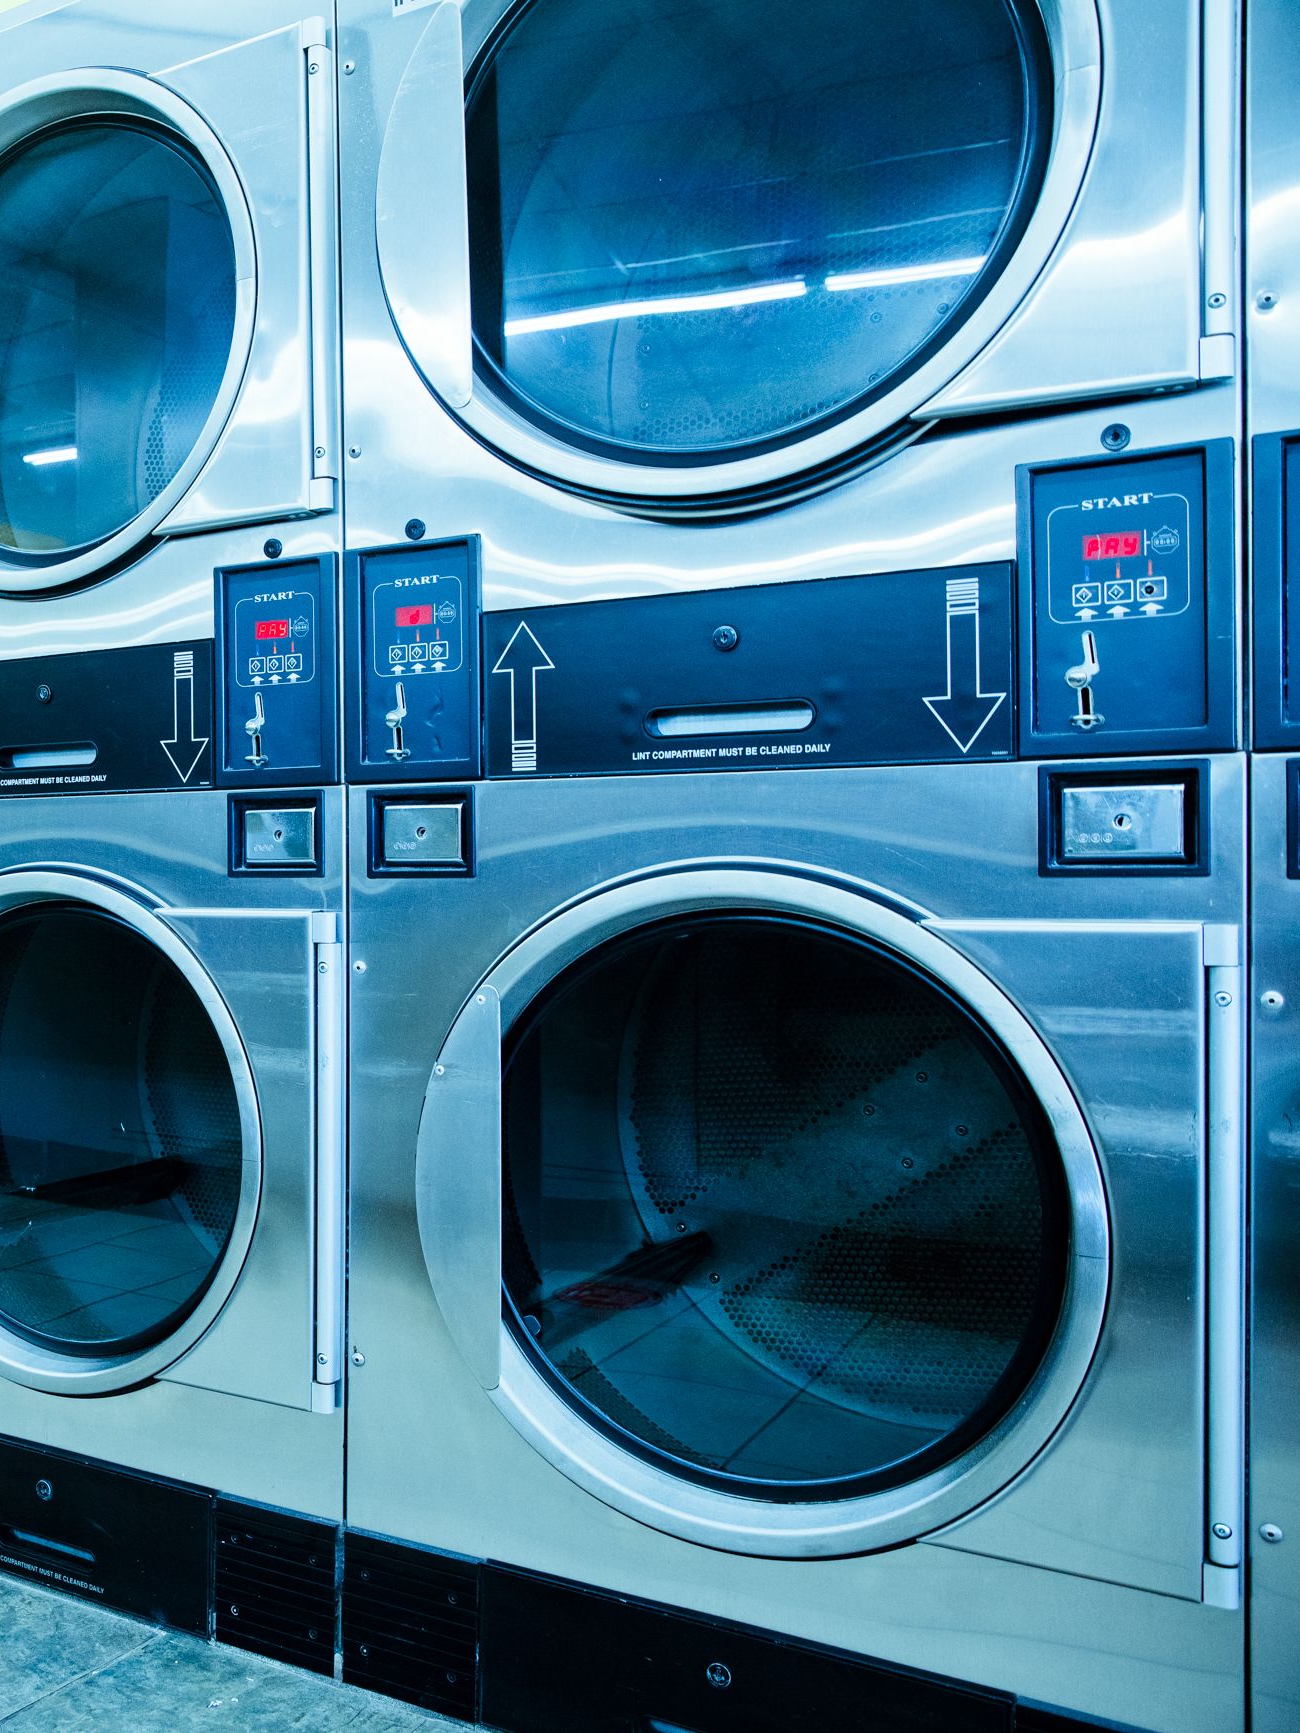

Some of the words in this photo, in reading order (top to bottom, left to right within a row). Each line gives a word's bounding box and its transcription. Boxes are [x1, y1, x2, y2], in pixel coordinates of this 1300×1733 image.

[1081, 492, 1154, 511] START
[394, 574, 440, 588] START
[254, 591, 295, 603] START
[632, 752, 650, 761] LINT
[652, 748, 717, 760] COMPARTMENT
[718, 747, 743, 757] MUST
[745, 747, 758, 756] BE
[760, 744, 802, 755] CLEANED
[804, 743, 831, 753] DAILY
[0, 777, 39, 786] COMPARTMENT
[39, 776, 55, 784] MUST
[55, 776, 64, 784] BE
[64, 775, 90, 783] CLEANED
[91, 774, 107, 782] DAILY
[0, 1553, 39, 1572] COMPARTMENT
[38, 1567, 54, 1578] MUST
[54, 1571, 63, 1581] BE
[62, 1575, 89, 1589] CLEANED
[88, 1584, 106, 1594] DAILY
